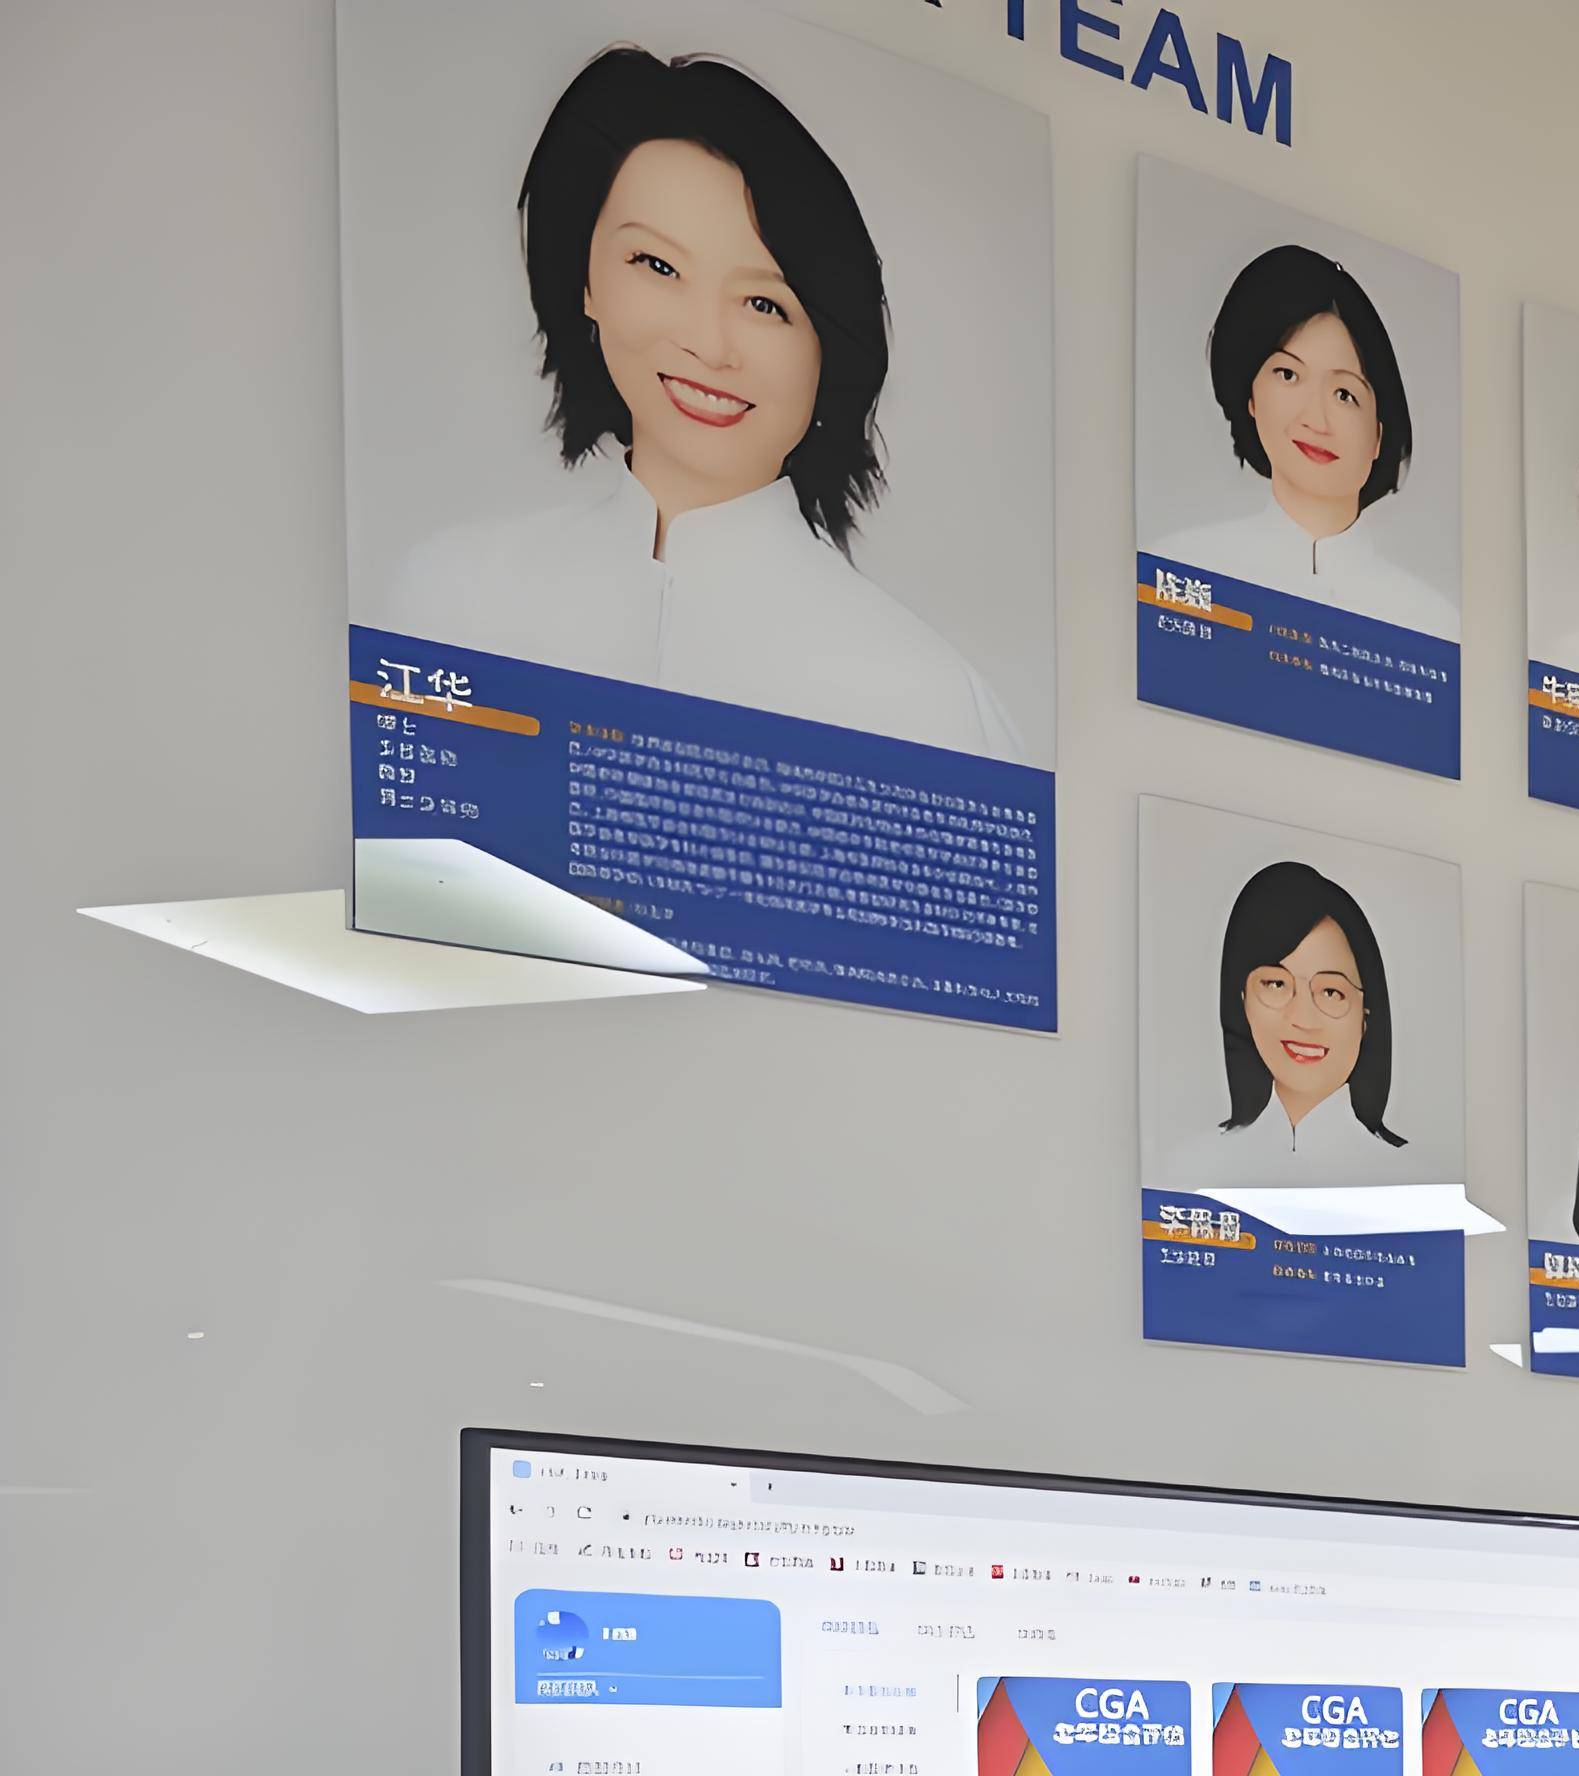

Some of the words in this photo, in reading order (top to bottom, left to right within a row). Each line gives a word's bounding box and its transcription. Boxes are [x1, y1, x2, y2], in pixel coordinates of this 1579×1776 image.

[377, 657, 473, 713] 江华
[1075, 1687, 1149, 1721] CGA
[1301, 1696, 1367, 1725] CGA
[1498, 1699, 1559, 1725] CGA
